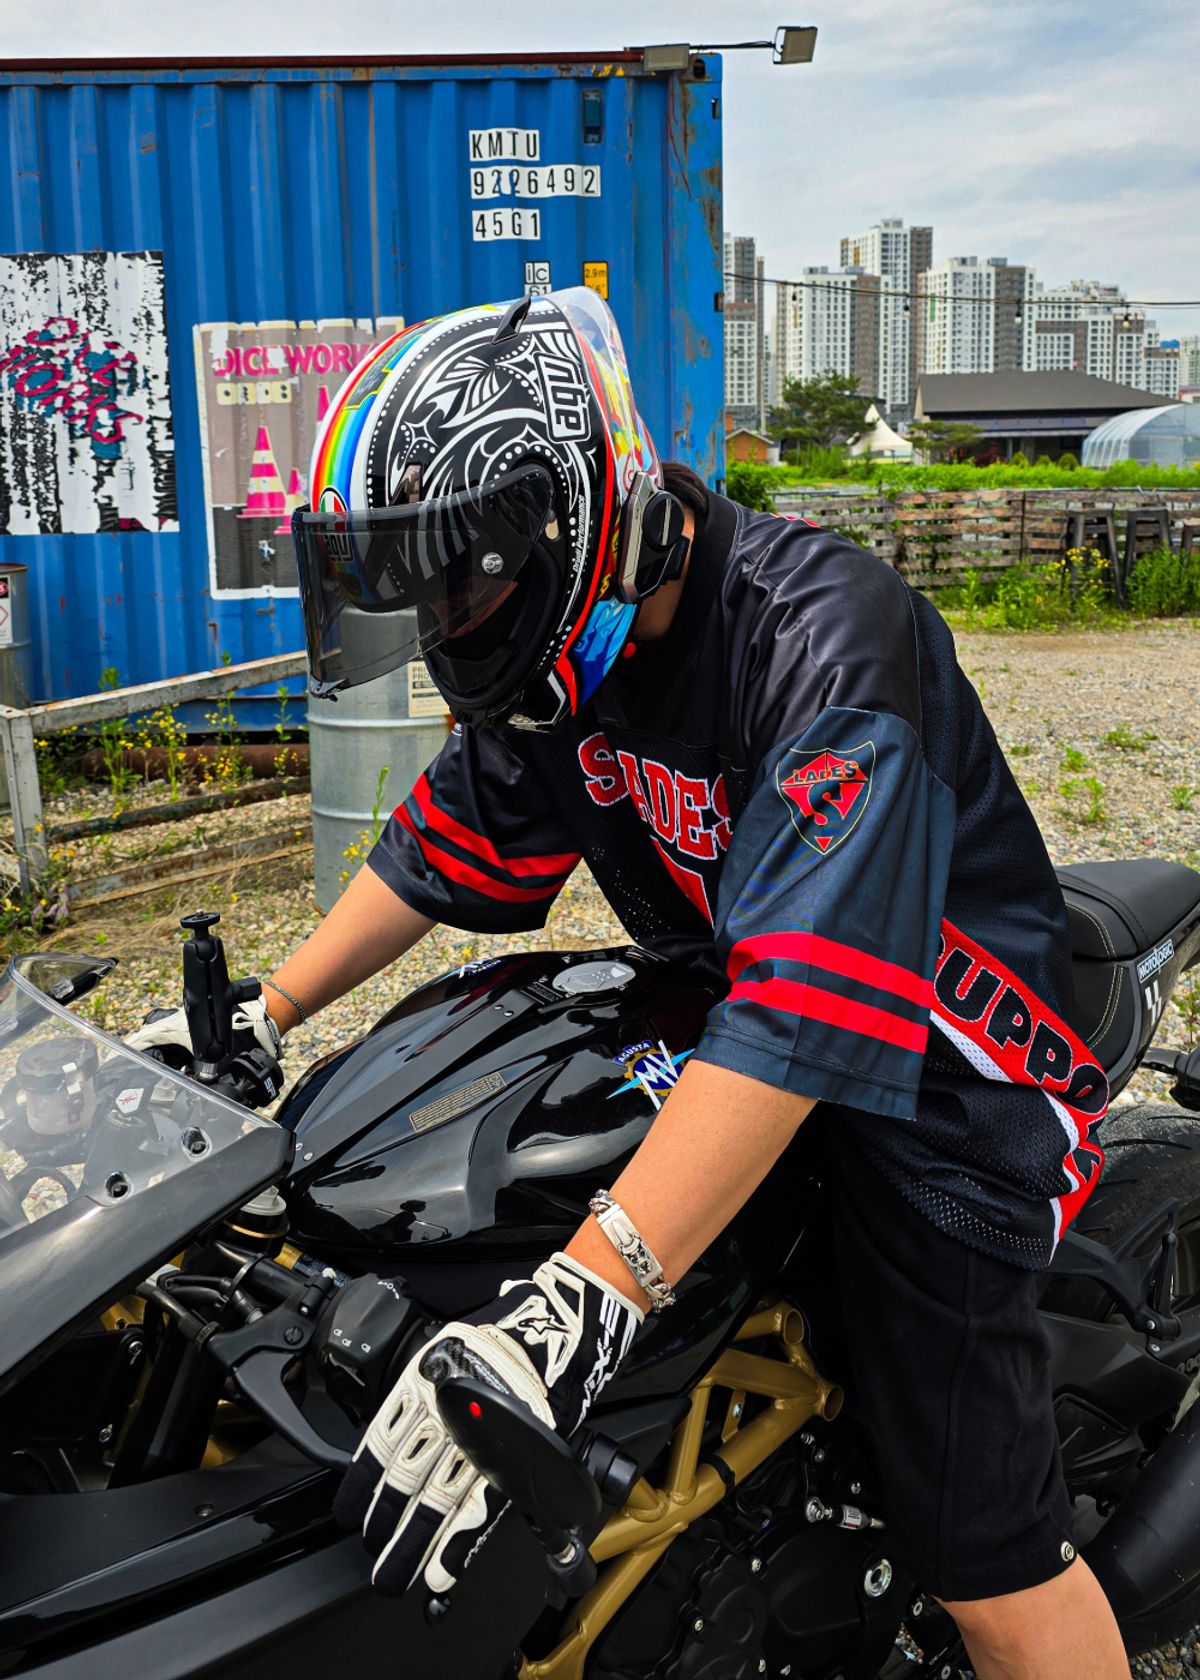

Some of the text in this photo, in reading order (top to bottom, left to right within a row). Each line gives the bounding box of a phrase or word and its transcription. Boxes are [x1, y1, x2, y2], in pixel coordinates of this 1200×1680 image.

[472, 131, 537, 159] KMTU
[473, 168, 596, 195] 9226492
[475, 211, 538, 238] 45G1
